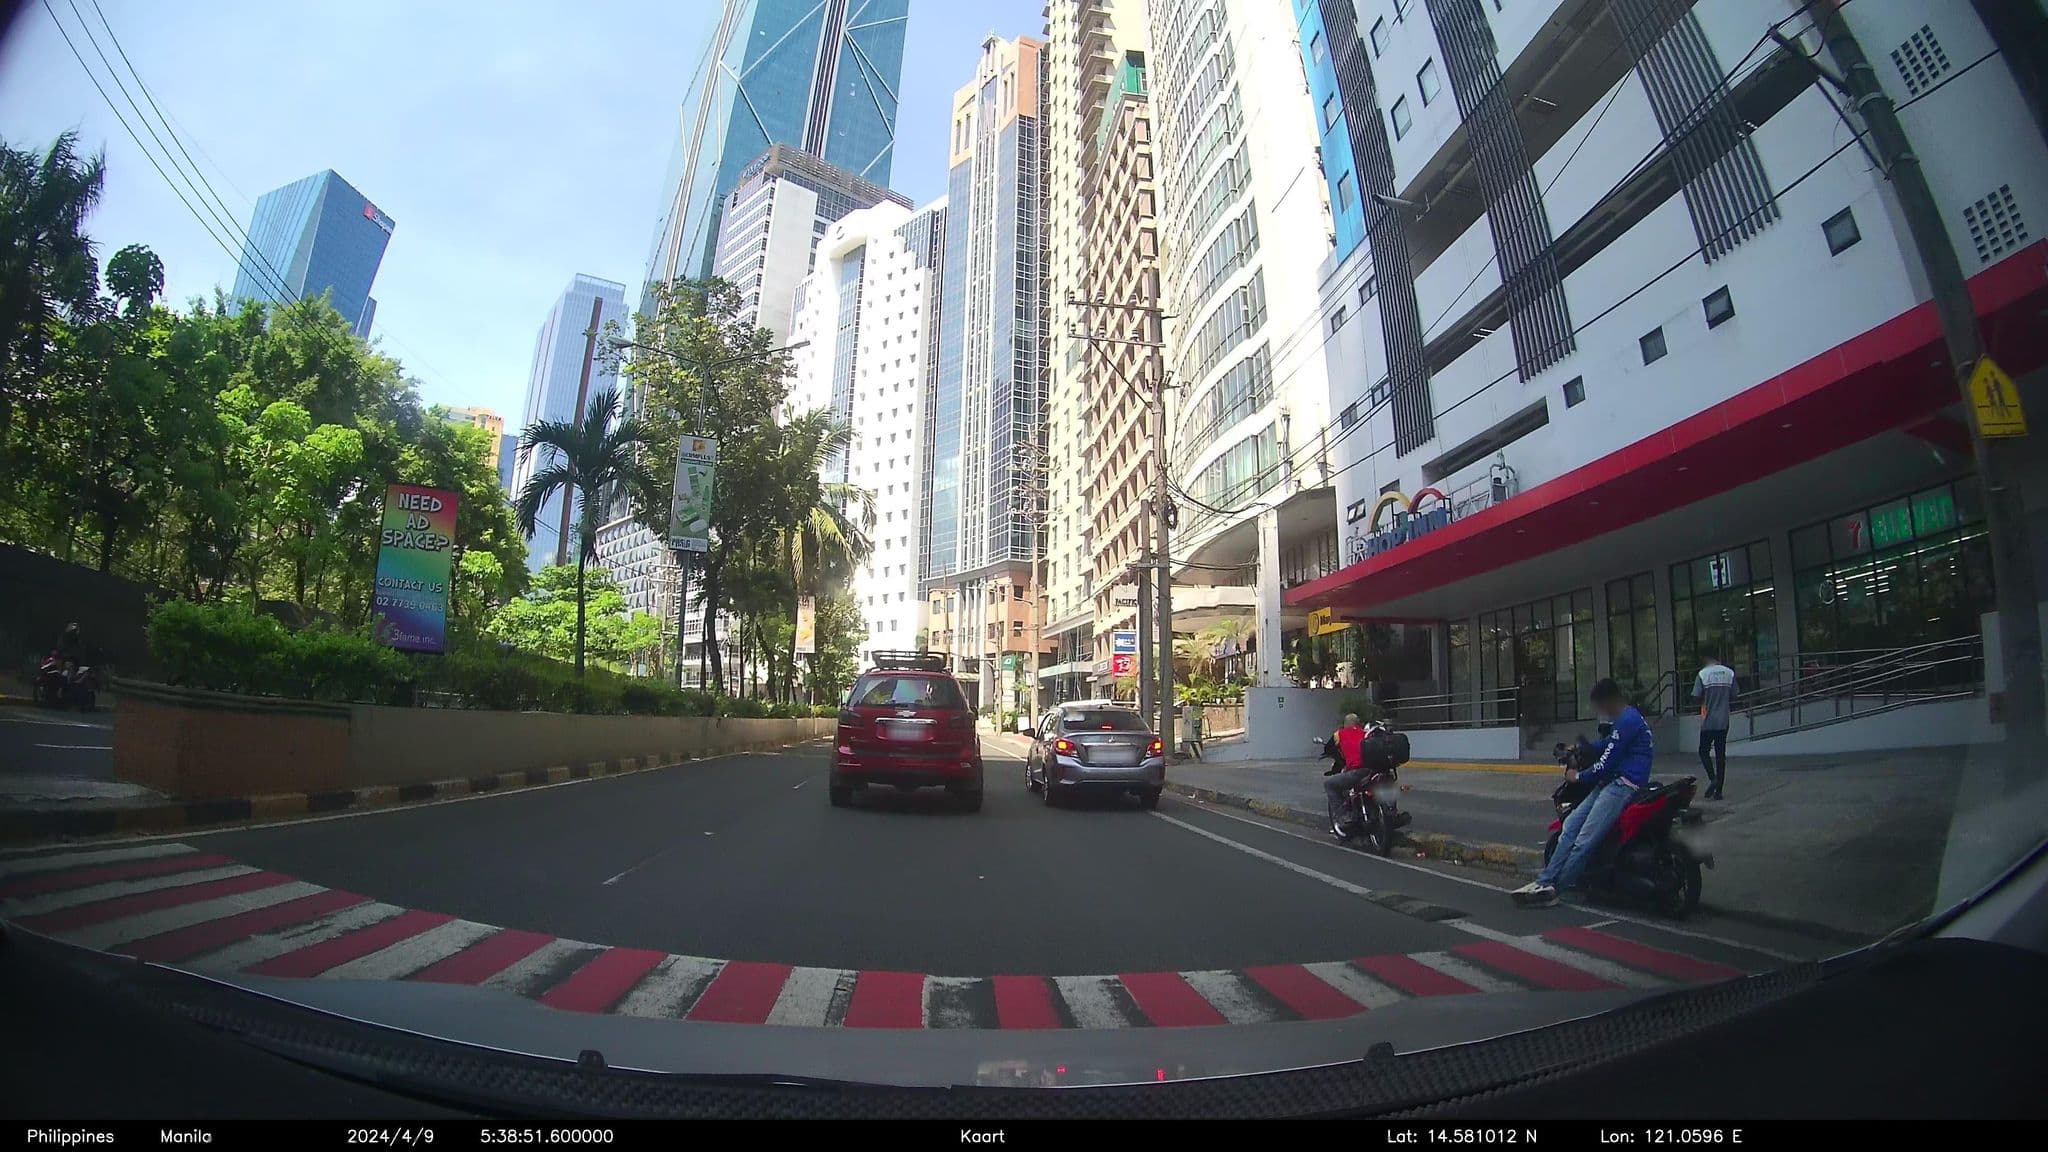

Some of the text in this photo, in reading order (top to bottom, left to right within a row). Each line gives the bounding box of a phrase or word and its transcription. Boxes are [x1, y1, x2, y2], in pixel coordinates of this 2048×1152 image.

[399, 493, 442, 512] NEED
[406, 512, 430, 530] AD
[382, 529, 450, 551] SPACE?
[378, 577, 443, 592] CONTACT US
[376, 597, 389, 606] 02
